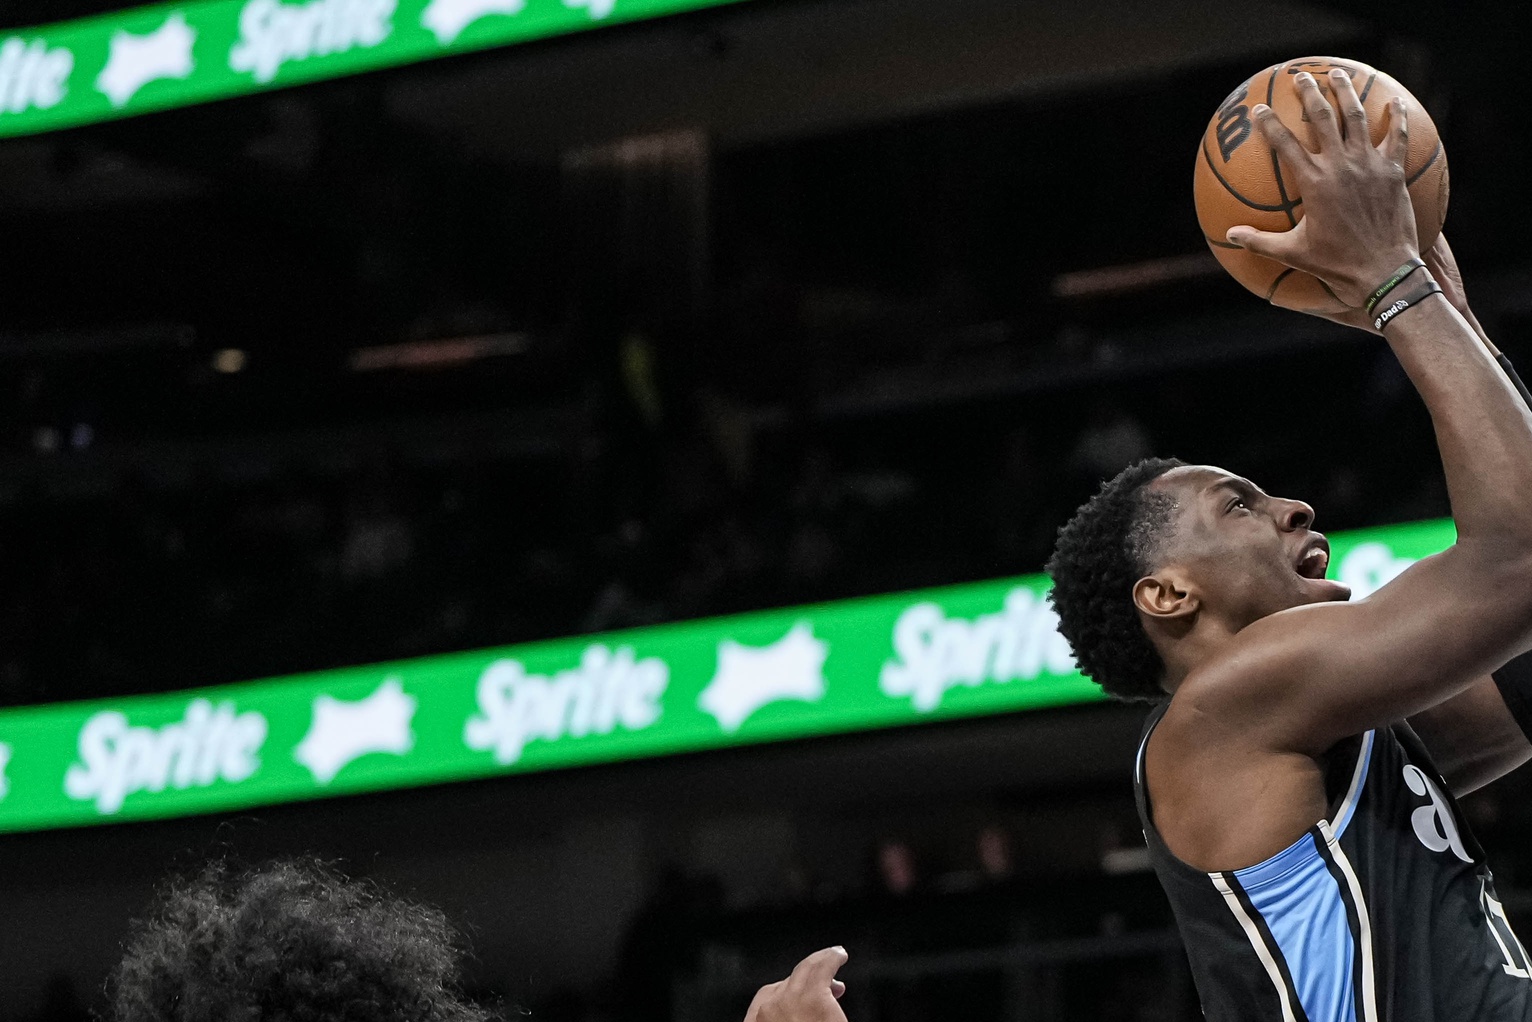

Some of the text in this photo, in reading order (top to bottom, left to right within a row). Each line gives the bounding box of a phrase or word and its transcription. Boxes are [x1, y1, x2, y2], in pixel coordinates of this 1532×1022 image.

[1380, 304, 1399, 322] Dad
[64, 698, 268, 815] Sprite
[463, 643, 670, 766] Sprite
